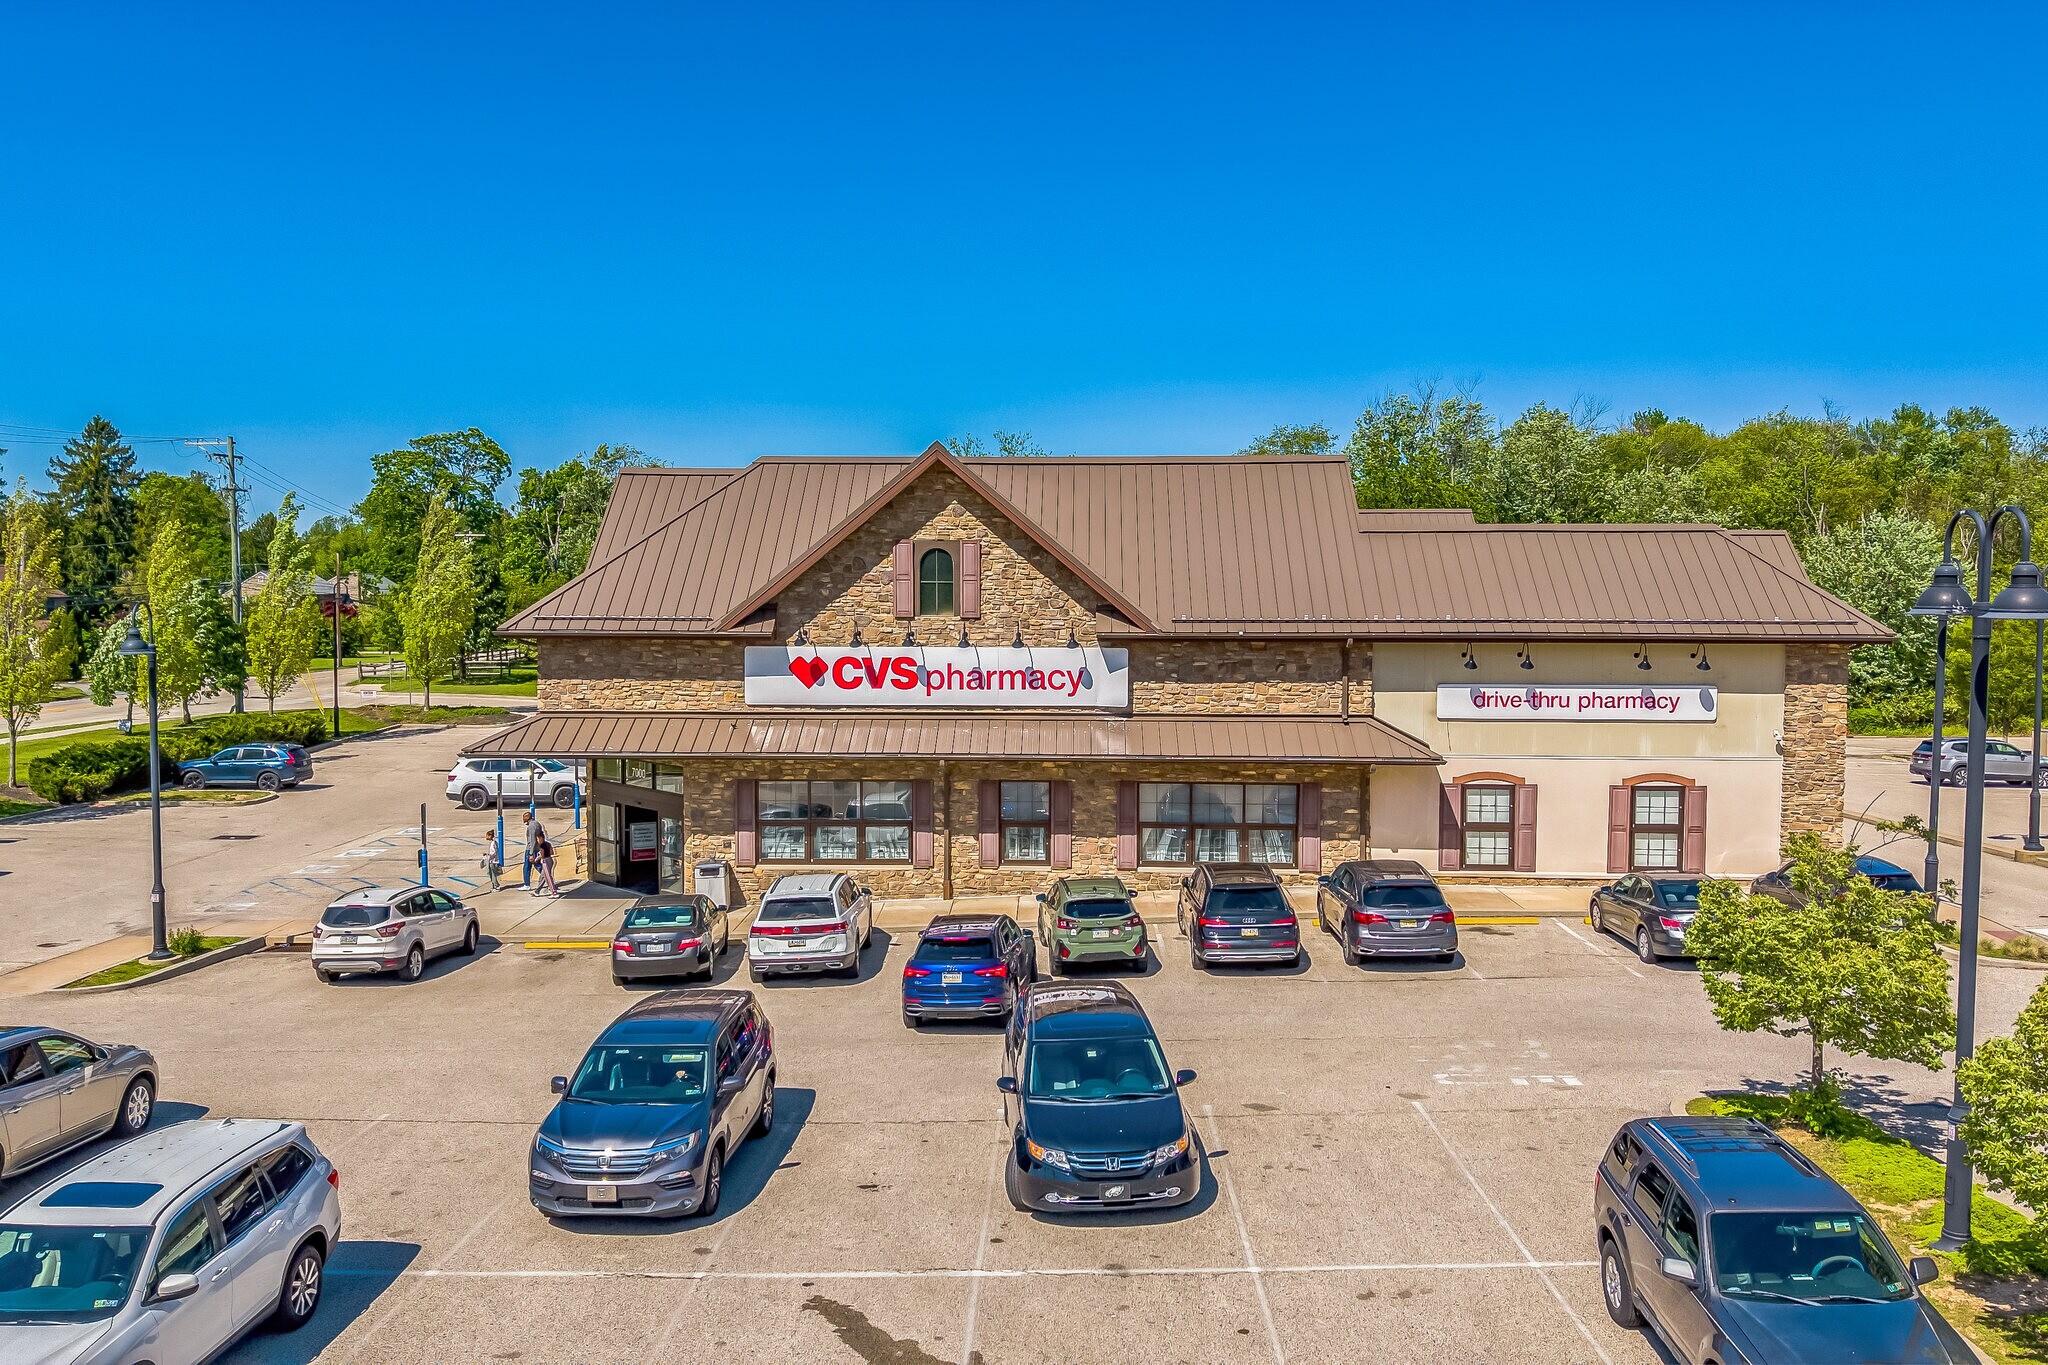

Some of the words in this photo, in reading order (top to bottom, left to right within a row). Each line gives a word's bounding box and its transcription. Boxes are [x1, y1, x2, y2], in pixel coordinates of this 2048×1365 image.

[832, 656, 918, 690] CVS
[926, 663, 1083, 697] pharmacy
[1474, 691, 1570, 708] drive-thru
[1578, 692, 1680, 713] pharmacy
[631, 767, 645, 778] 7000
